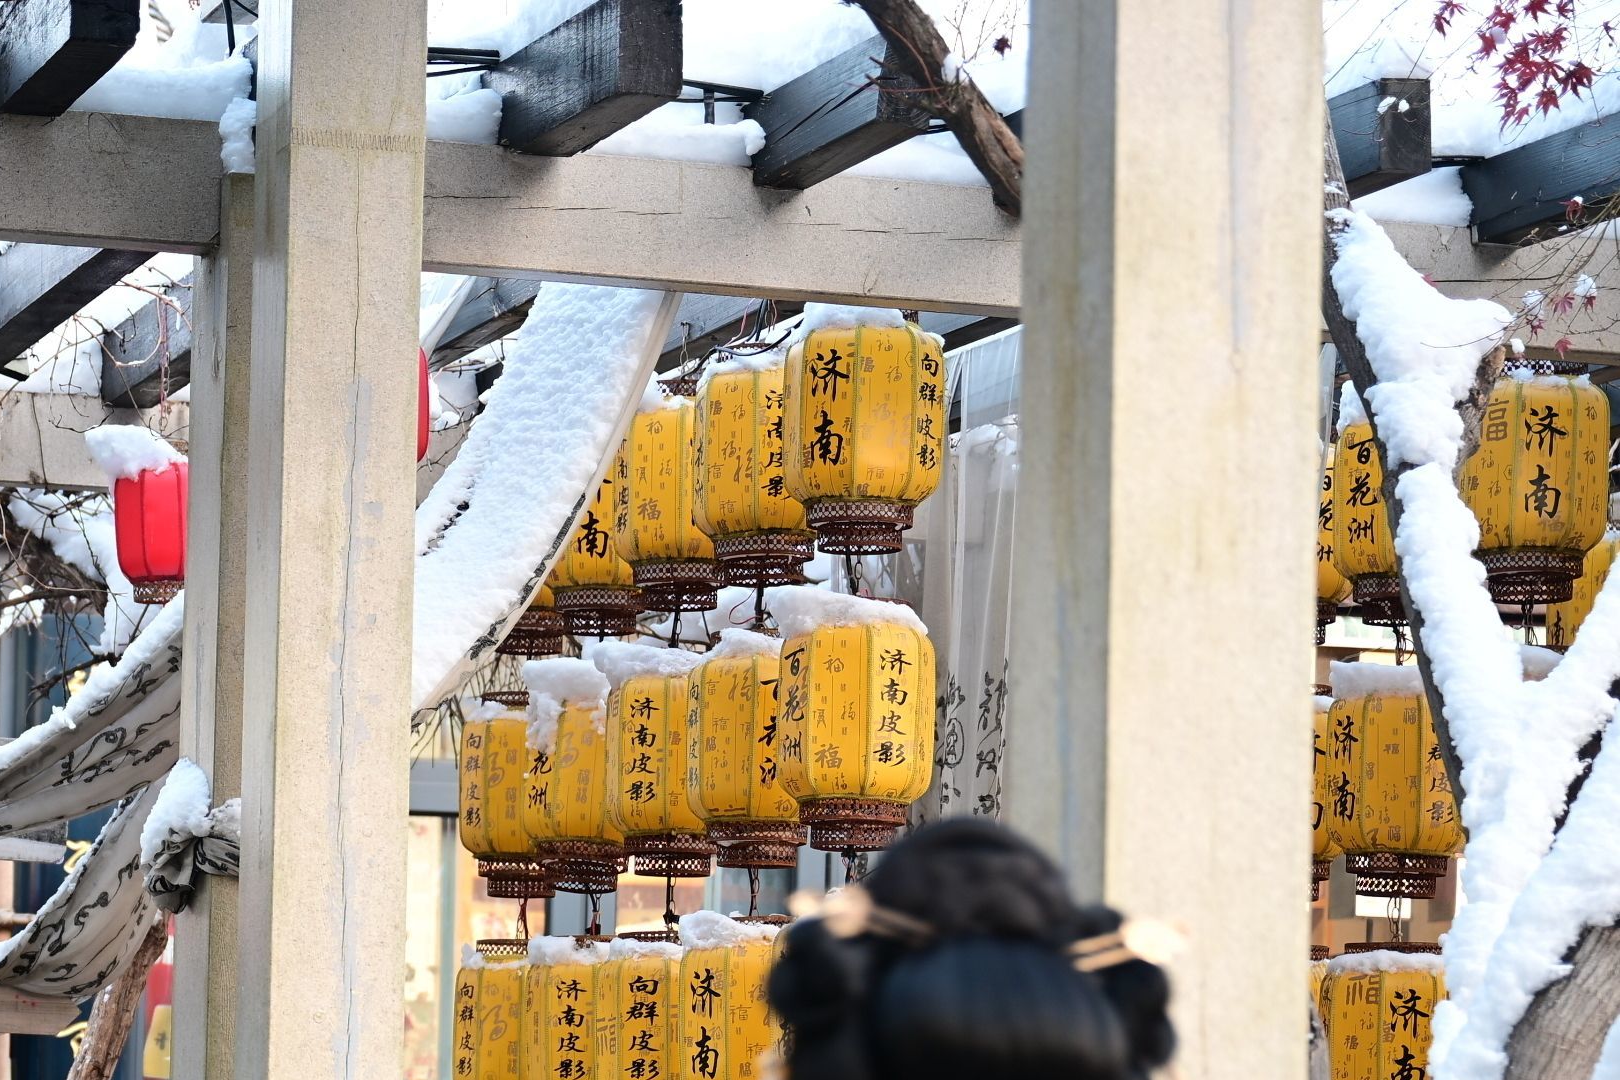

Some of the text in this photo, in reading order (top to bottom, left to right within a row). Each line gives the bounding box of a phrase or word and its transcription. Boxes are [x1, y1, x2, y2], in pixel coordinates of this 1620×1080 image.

[810, 348, 850, 467] 济南
[916, 352, 940, 471] 向群皮影
[1524, 405, 1567, 519] 济南
[1346, 438, 1378, 545] 百花洲
[624, 697, 660, 804] 济南皮影
[782, 647, 806, 764] 百花洲
[872, 648, 912, 767] 济南皮影
[463, 733, 482, 828] 向群皮影
[1333, 715, 1359, 822] 济南
[455, 982, 475, 1077] 向群皮影
[553, 979, 587, 1080] 济南皮影
[690, 968, 722, 1080] 济南
